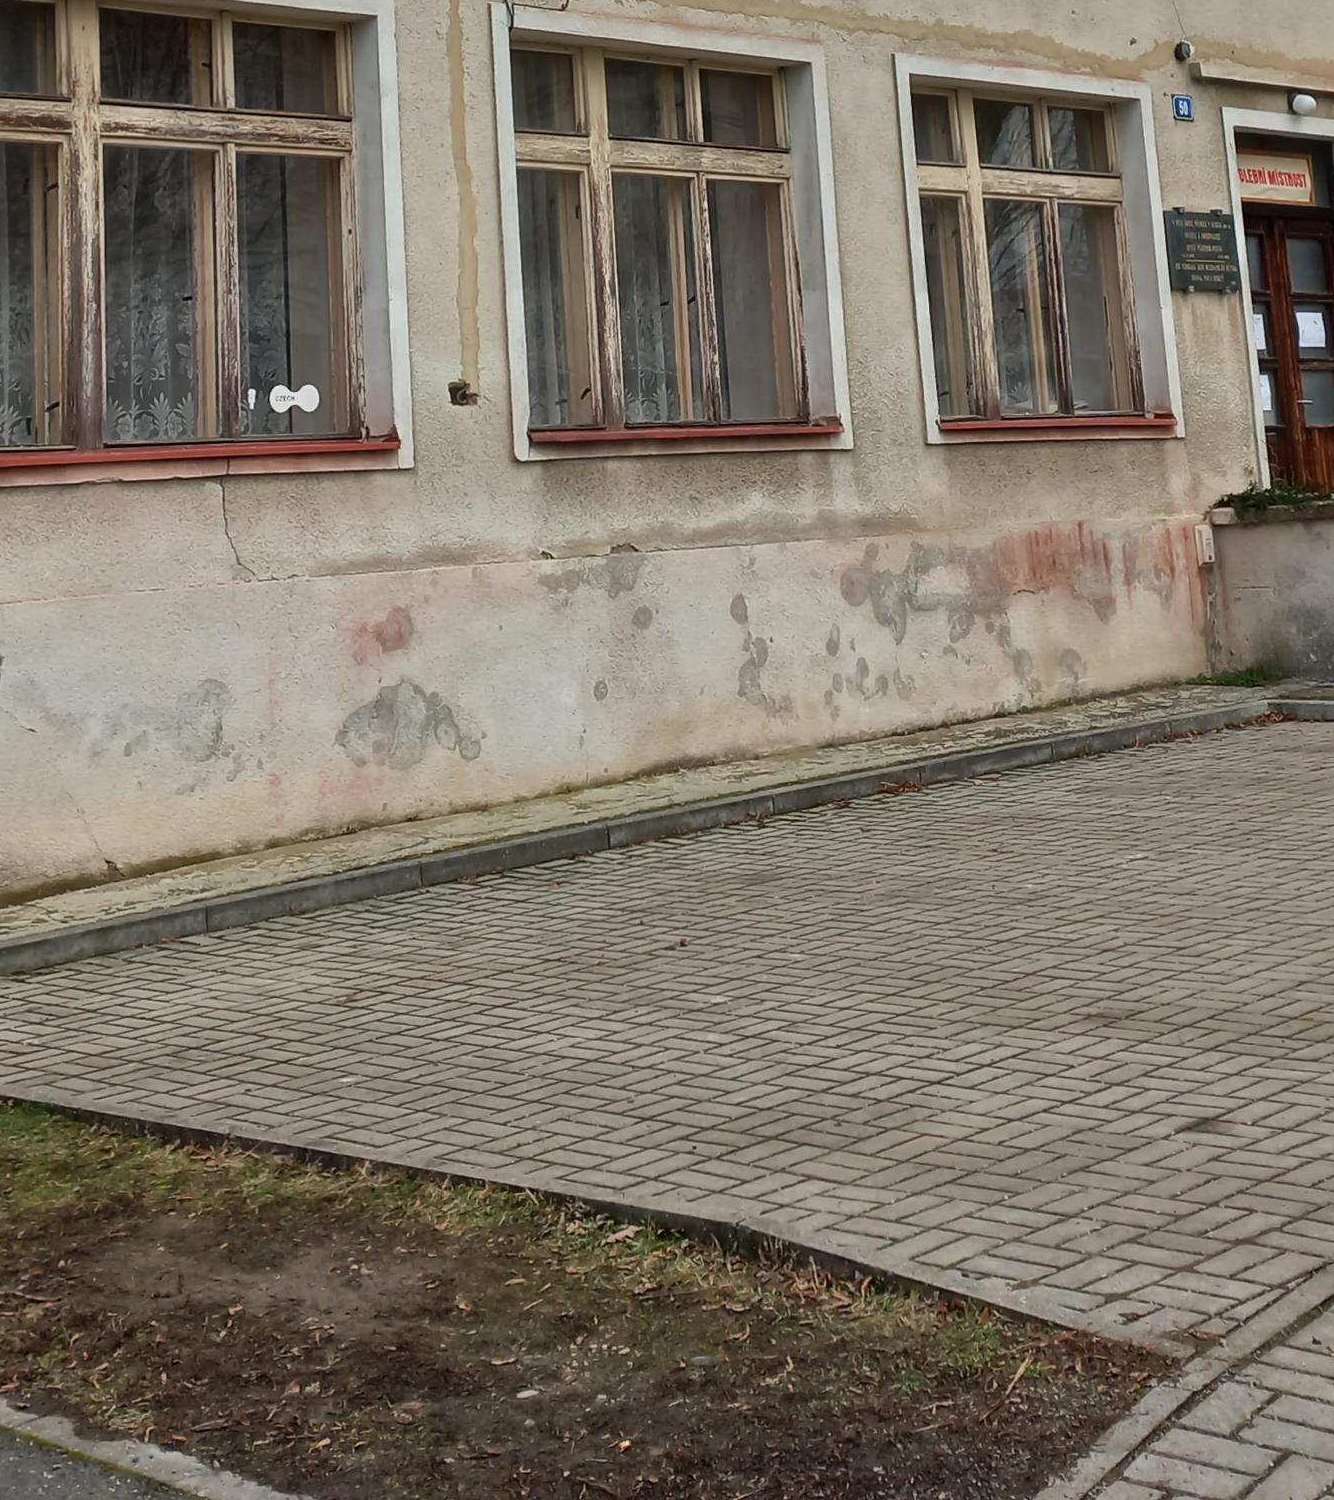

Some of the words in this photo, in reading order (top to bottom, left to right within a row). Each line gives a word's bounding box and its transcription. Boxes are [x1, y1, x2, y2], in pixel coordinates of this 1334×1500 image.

[1178, 100, 1189, 116] 50
[1237, 168, 1267, 184] OLEBNÍ
[1267, 169, 1307, 188] MÍSTNOST
